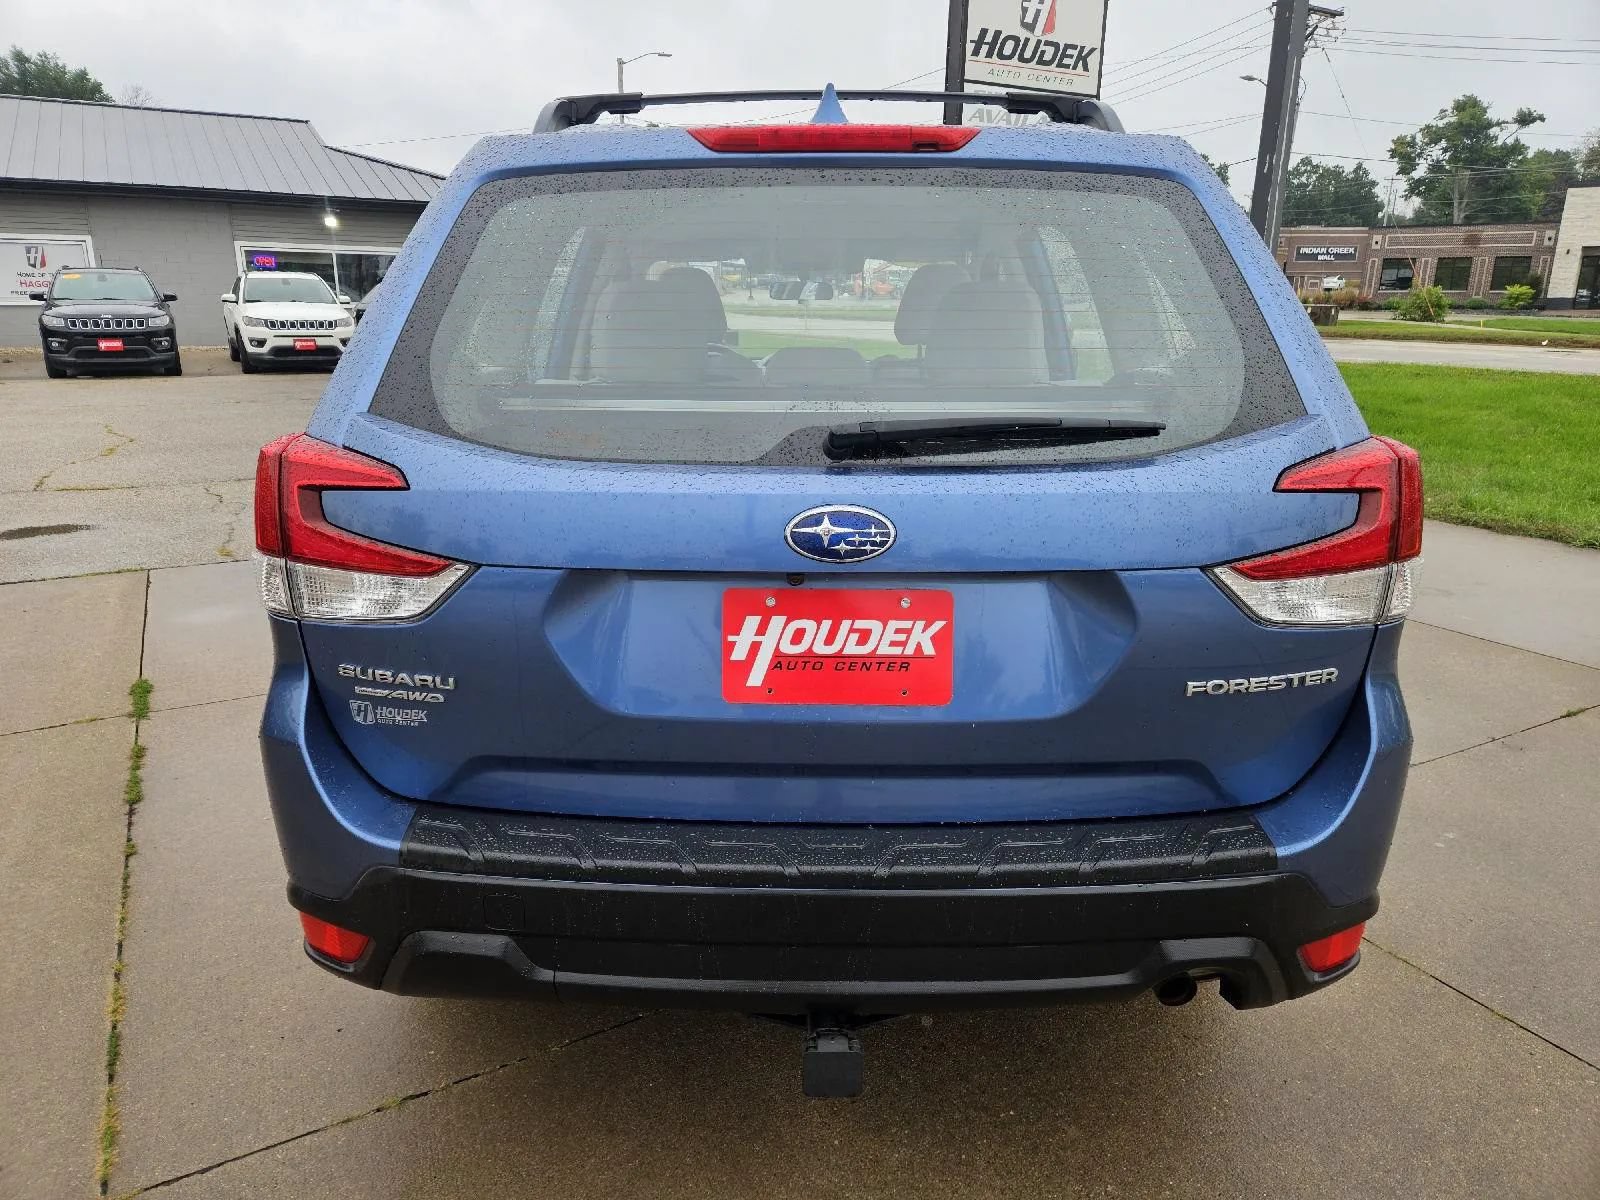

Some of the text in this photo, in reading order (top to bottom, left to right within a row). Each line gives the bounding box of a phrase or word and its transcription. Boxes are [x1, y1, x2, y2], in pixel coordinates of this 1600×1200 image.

[969, 27, 1098, 73] HOUDEK
[987, 68, 1074, 86] AUTO CENTER
[254, 256, 275, 267] OPEN
[727, 615, 949, 687] HOUDEK
[771, 661, 911, 672] AUTO CENTER
[337, 663, 456, 690] SUBARU
[1185, 667, 1339, 697] FORESTER
[388, 690, 446, 703] AWD
[375, 705, 427, 720] HOUDEK
